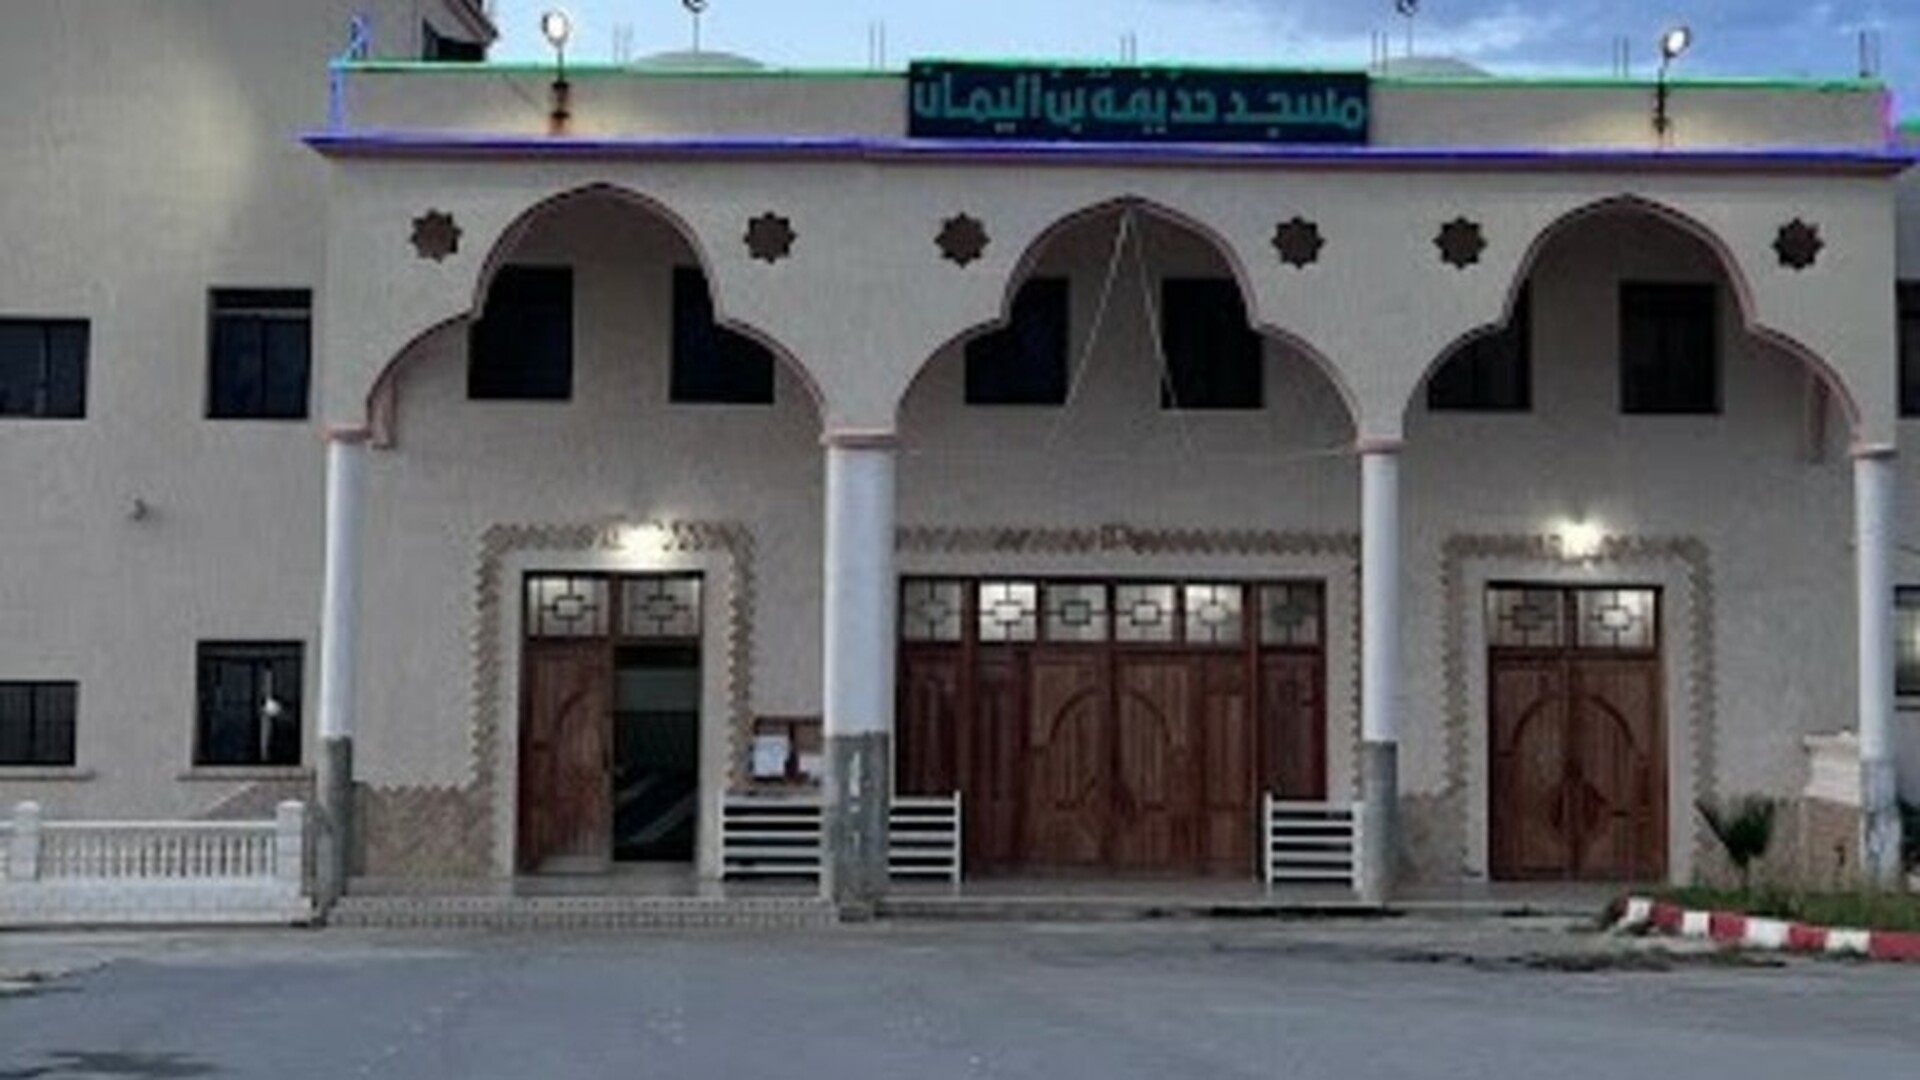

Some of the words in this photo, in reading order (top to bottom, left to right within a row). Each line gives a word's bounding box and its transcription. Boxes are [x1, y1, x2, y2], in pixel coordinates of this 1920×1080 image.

[913, 66, 1042, 134] اليمان
[1044, 71, 1086, 134] بن
[1222, 87, 1365, 138] مسجد
